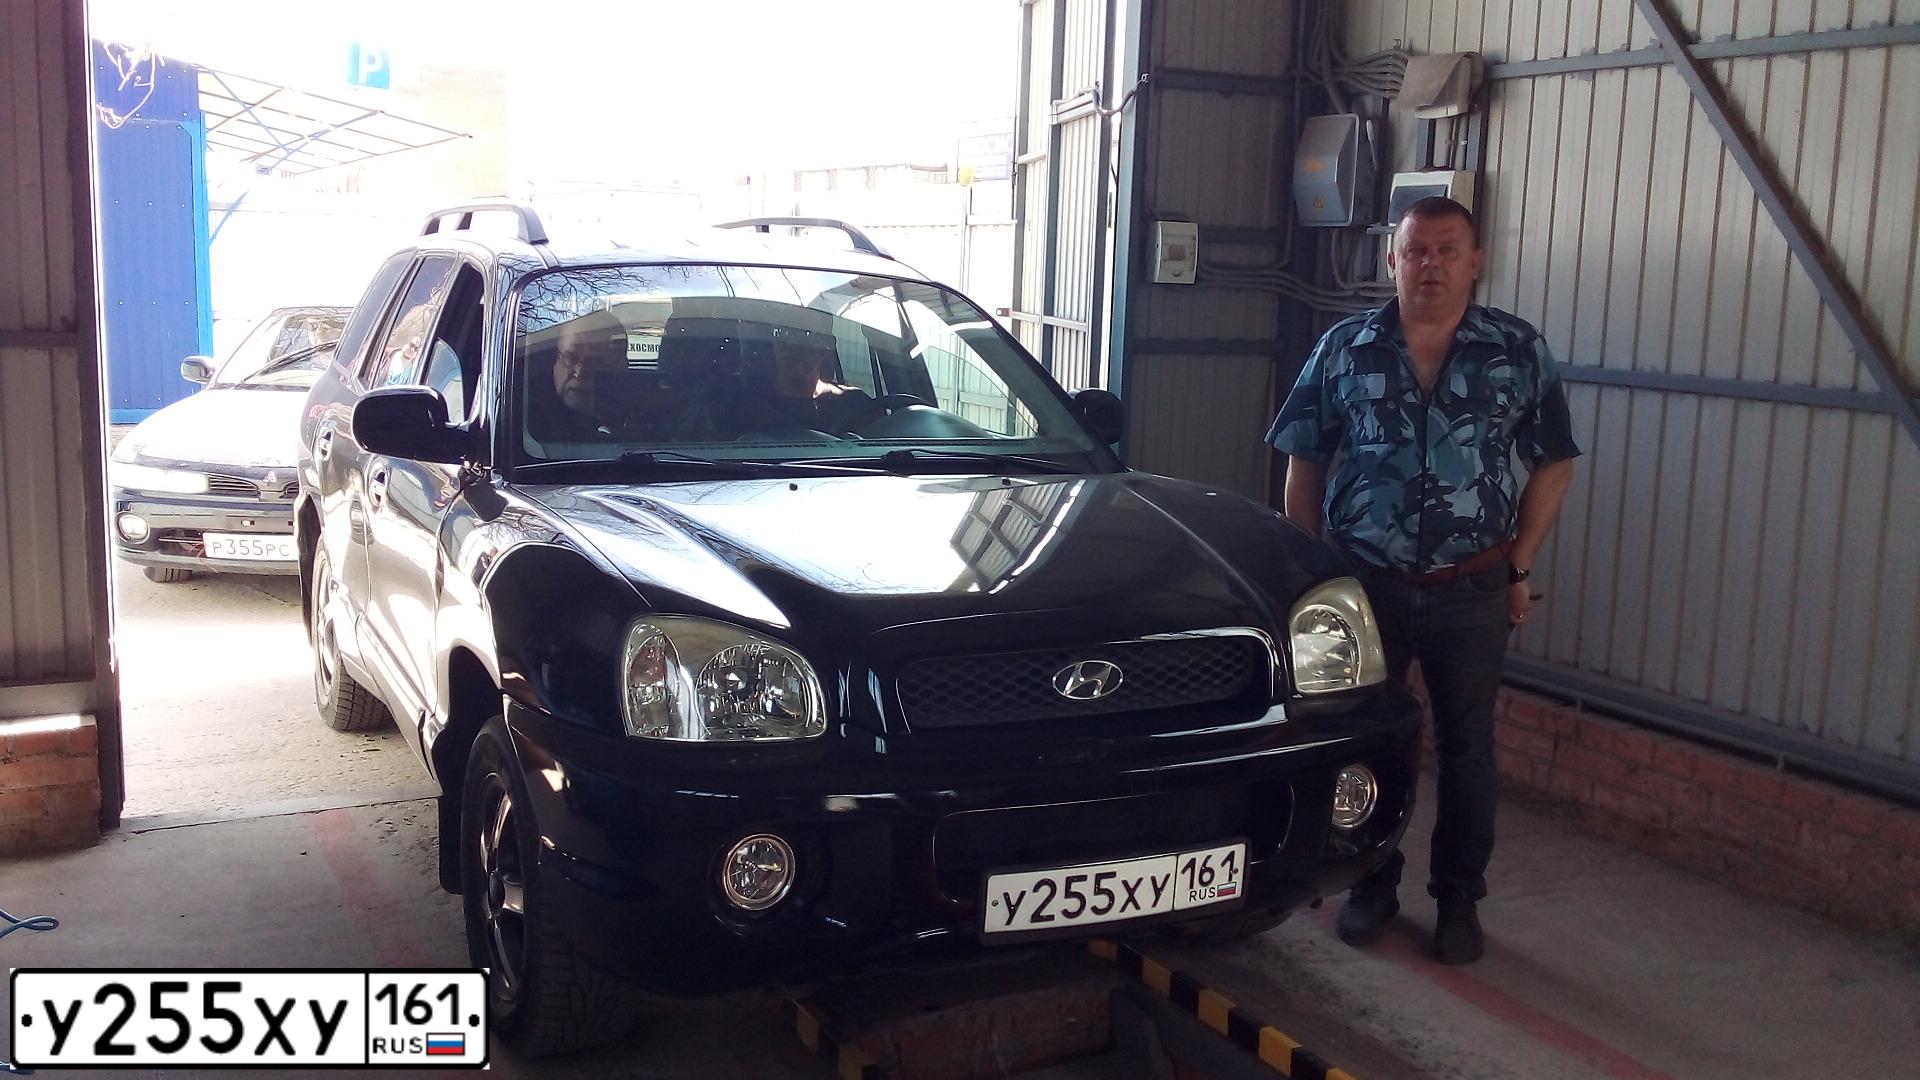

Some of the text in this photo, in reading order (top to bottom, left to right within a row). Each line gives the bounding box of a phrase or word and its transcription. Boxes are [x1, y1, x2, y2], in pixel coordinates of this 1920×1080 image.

[359, 48, 383, 84] P
[1003, 851, 1237, 926] У255ХУ 161
[1189, 887, 1216, 902] RUS
